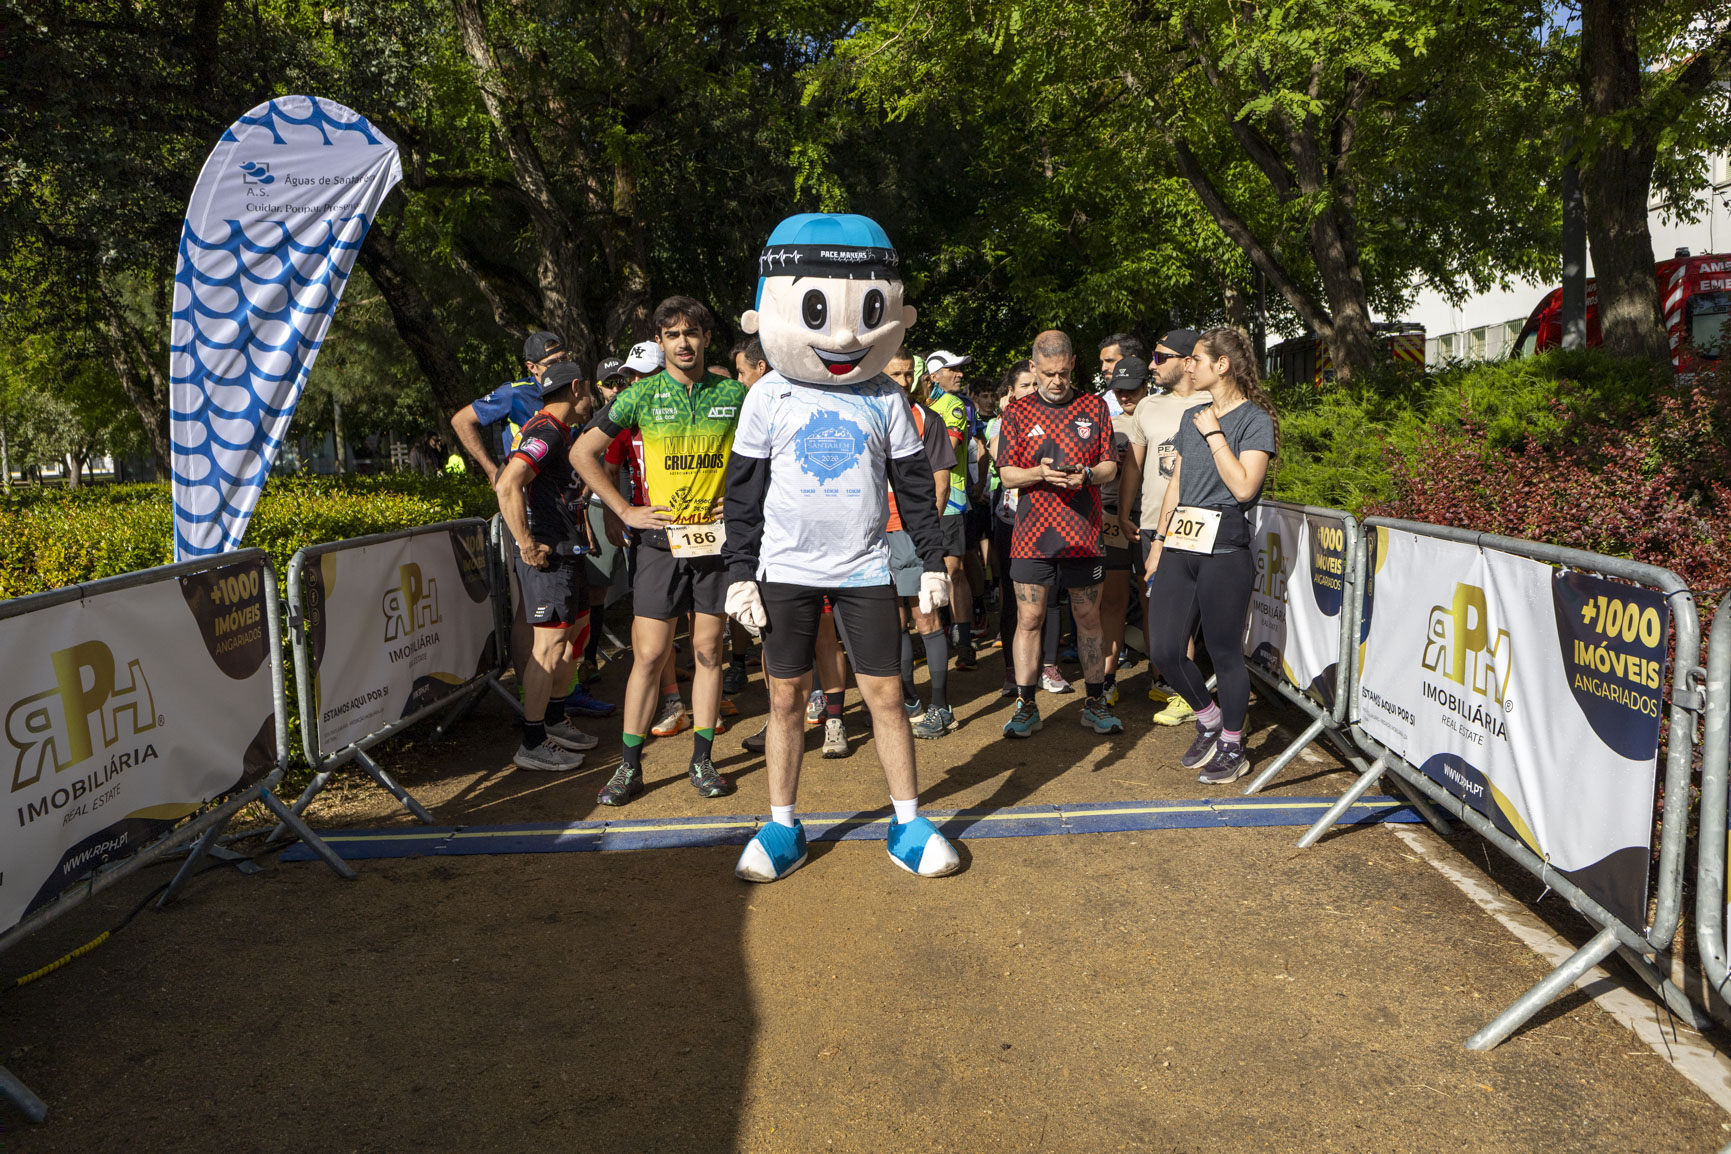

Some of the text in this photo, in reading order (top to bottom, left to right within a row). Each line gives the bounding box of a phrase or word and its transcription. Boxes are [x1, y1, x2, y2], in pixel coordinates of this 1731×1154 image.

[284, 173, 316, 187] Águas
[318, 175, 331, 186] de
[820, 250, 867, 259] PACE MAKERS
[630, 346, 646, 358] NY
[664, 453, 724, 470] CRUZADOS
[682, 531, 716, 546] 186
[1174, 518, 1205, 538] 207
[1315, 551, 1342, 575] IMÓVEIS
[210, 570, 259, 605] +1000
[215, 602, 261, 636] IMÓVEIS
[1581, 595, 1661, 648] +1000
[216, 626, 262, 655] ANGARIADOS
[1574, 639, 1660, 689] IMÓVEIS
[323, 702, 350, 723] ESTAMOS
[350, 694, 367, 709] AQUI
[367, 688, 383, 703] POR
[383, 686, 389, 696] SI
[1423, 681, 1508, 742] IMOBILIÁRIA
[1574, 673, 1658, 718] ANGARIADOS
[1381, 699, 1397, 716] AQUI
[1397, 707, 1410, 723] POR
[1409, 713, 1416, 727] SI
[1441, 714, 1485, 746] REAL ESTATE
[17, 743, 159, 828] IMOBILIÁRIA
[62, 783, 121, 827] REAL ESTATE
[63, 831, 129, 876] WWW.RPH.PT
